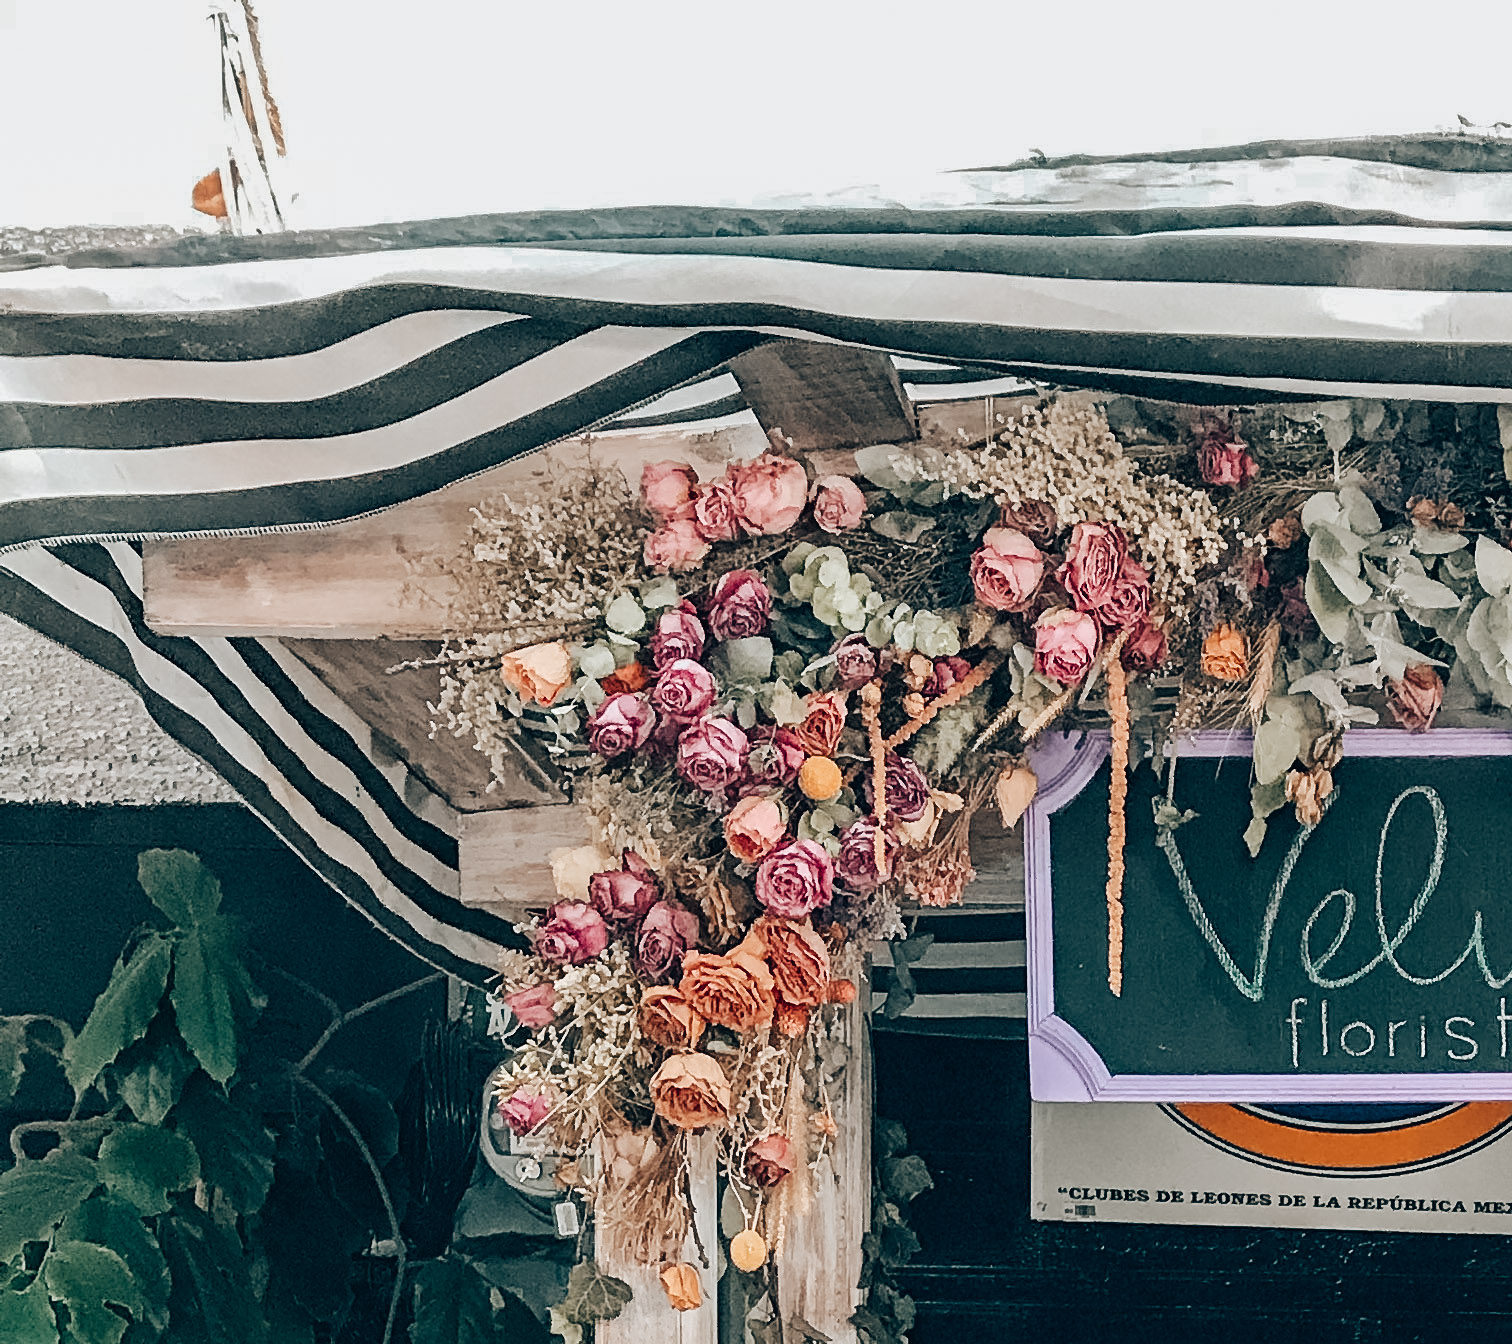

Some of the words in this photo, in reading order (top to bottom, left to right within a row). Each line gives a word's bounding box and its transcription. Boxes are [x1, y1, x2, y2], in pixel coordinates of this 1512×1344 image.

[1156, 1190, 1185, 1203] DE
[1190, 1191, 1273, 1206] LEONES
[1278, 1194, 1307, 1207] DE
[1312, 1195, 1342, 1209] LA
[1347, 1194, 1467, 1213] REPÚBLICA
